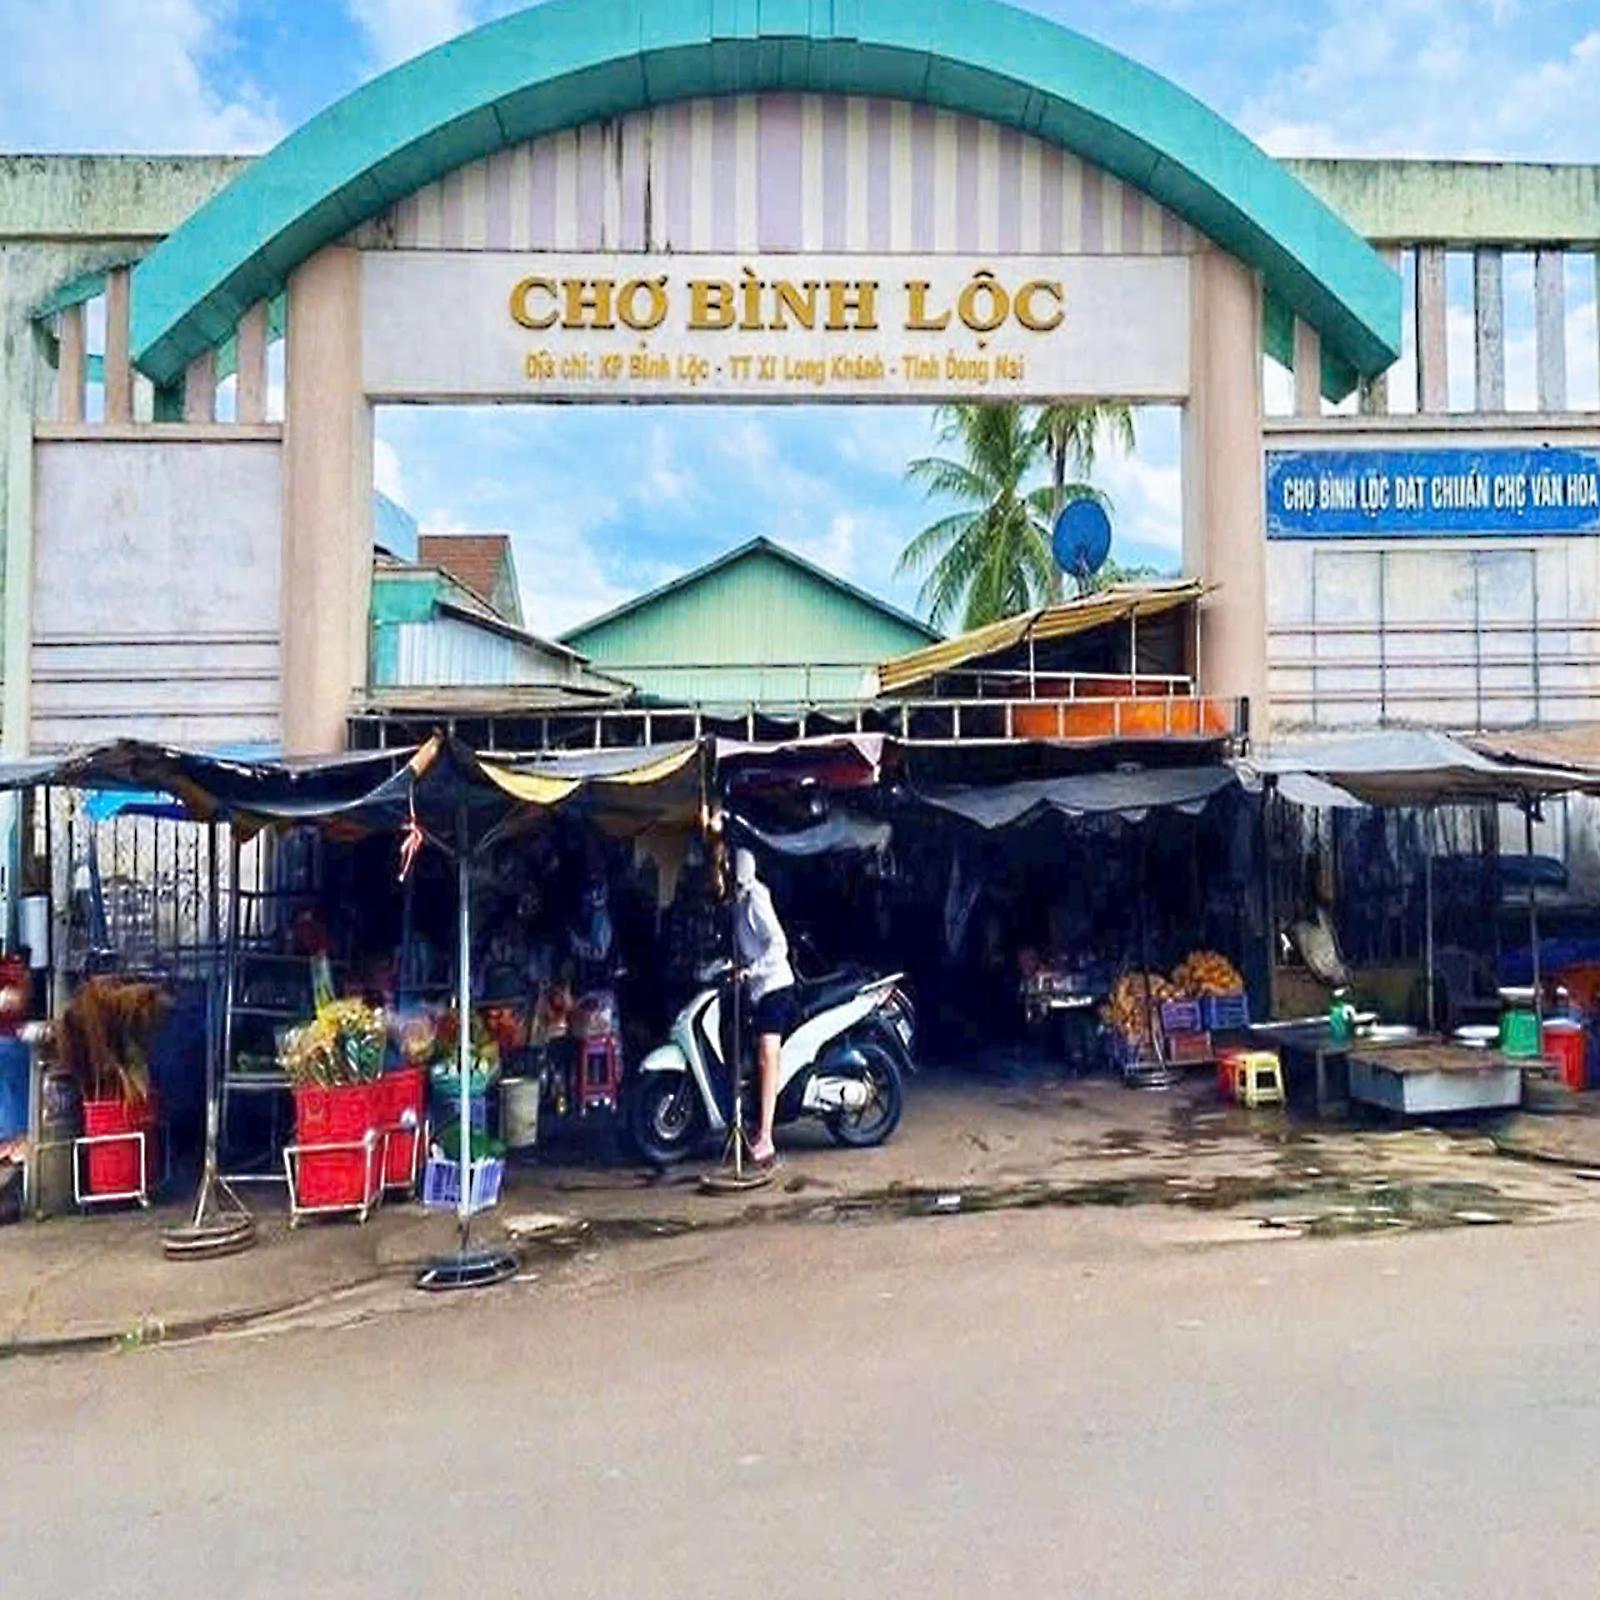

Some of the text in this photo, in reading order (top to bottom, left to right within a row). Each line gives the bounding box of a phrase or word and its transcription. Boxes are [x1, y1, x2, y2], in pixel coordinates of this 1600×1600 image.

[509, 266, 1065, 350] CHỢ BÌNH LỘC
[784, 353, 826, 386] Long
